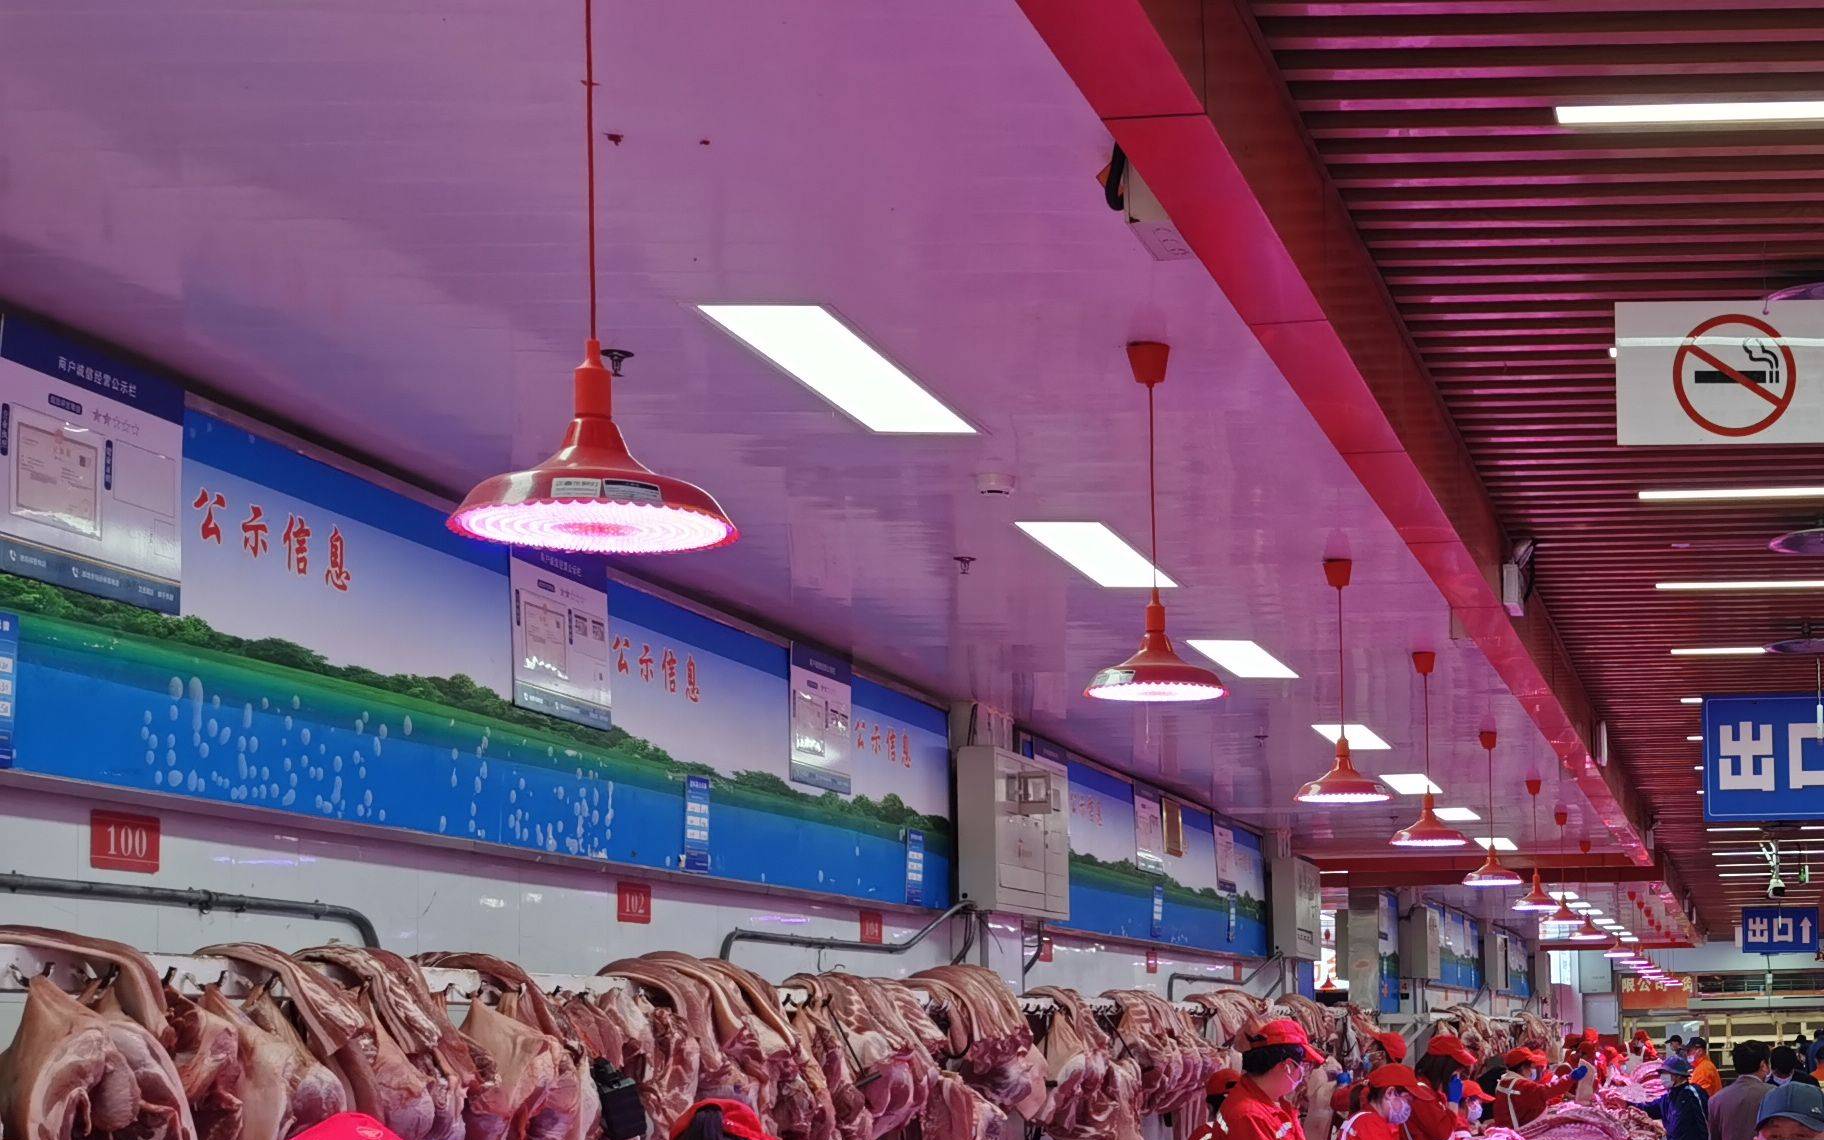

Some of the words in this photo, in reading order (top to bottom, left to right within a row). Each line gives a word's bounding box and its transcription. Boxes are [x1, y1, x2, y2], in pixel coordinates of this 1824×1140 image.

[193, 487, 352, 592] 公示信息
[612, 636, 700, 703] 公示信息
[854, 720, 912, 769] 公示信息
[106, 825, 149, 859] 100
[625, 892, 645, 914] 102
[1747, 917, 1794, 943] 出口
